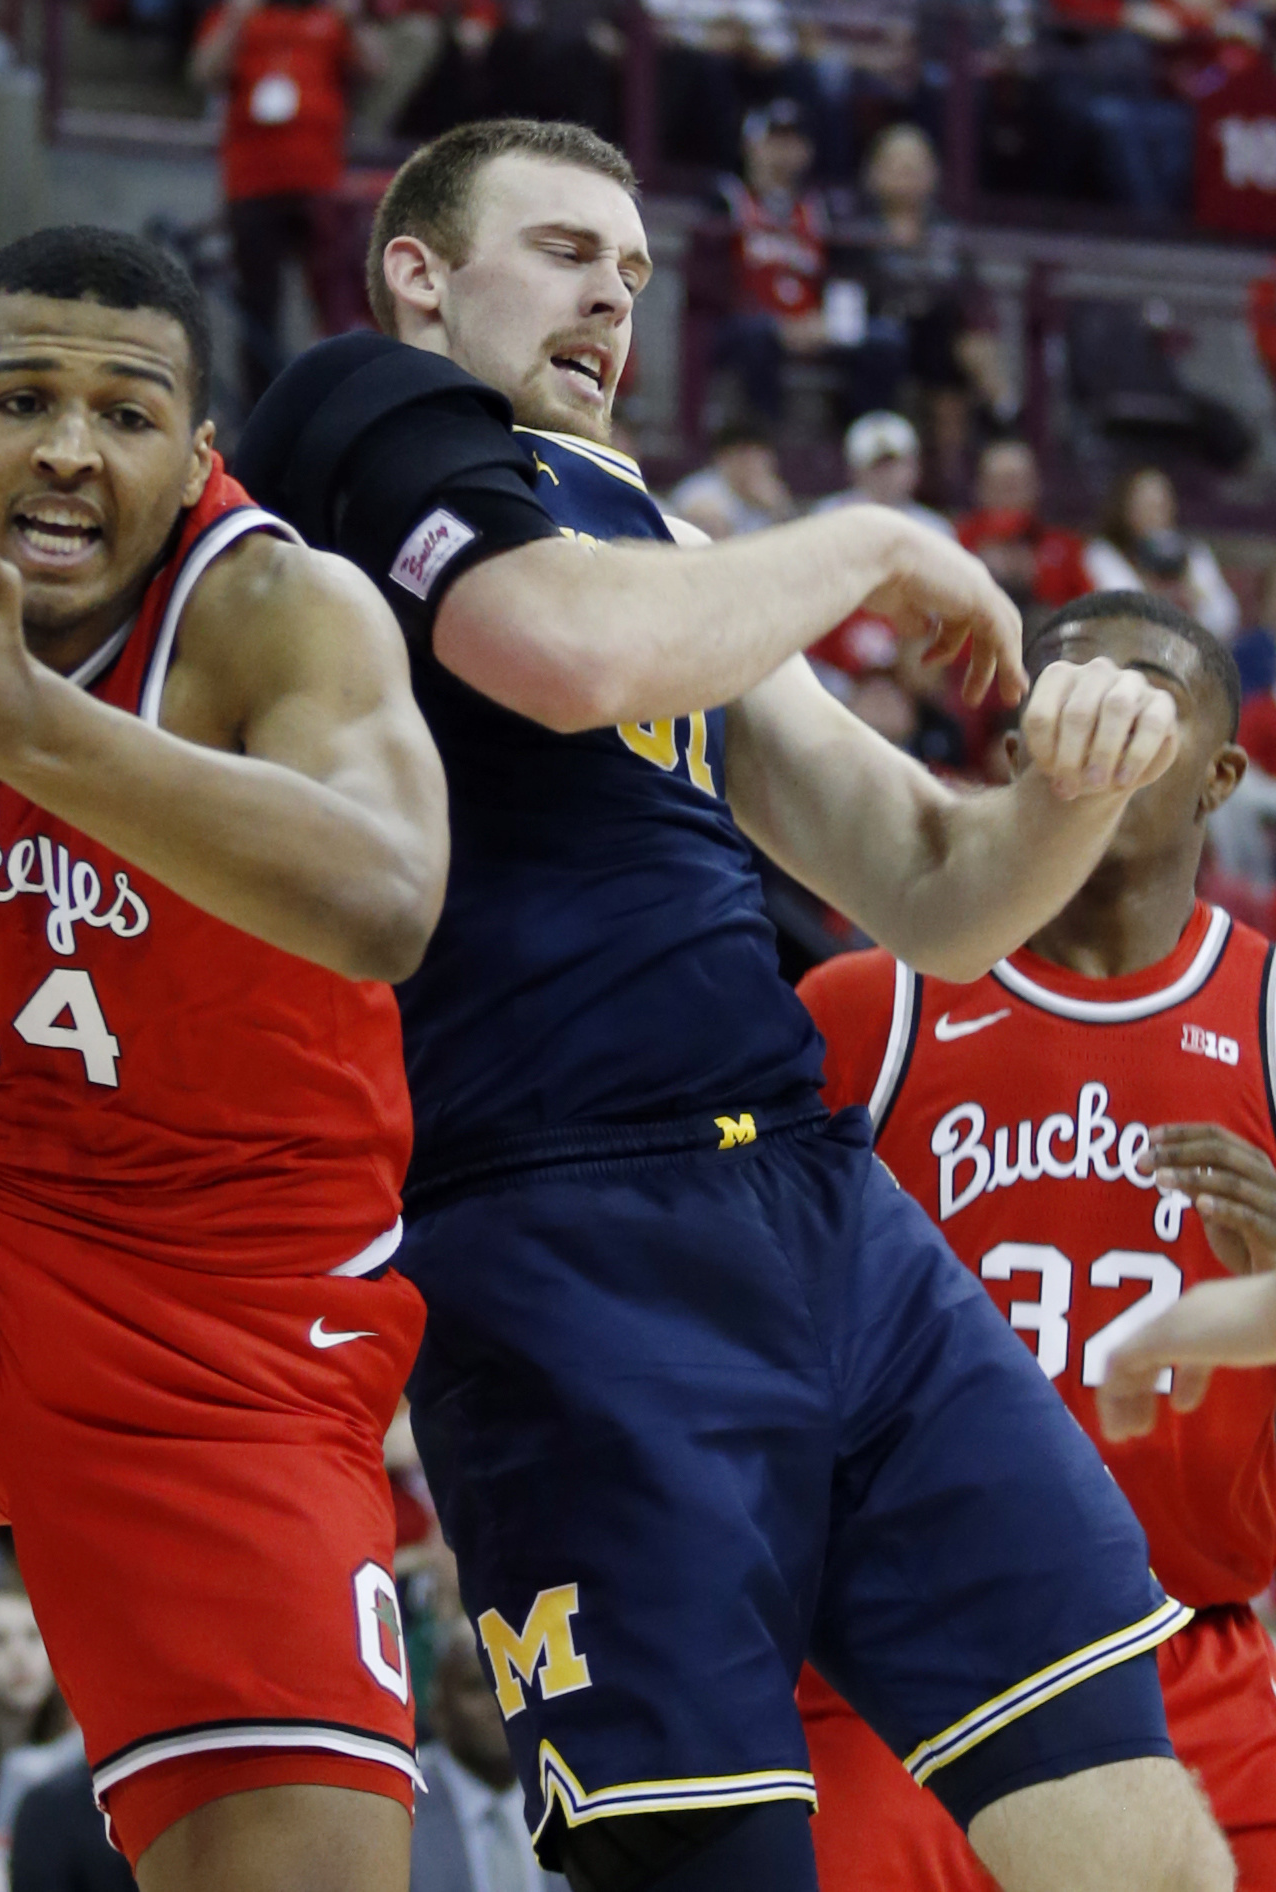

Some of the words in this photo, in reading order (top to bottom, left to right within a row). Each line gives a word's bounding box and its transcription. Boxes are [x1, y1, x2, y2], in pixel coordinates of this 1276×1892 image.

[713, 1112, 758, 1150] M
[979, 1240, 1185, 1396] 32
[476, 1581, 594, 1722] M
